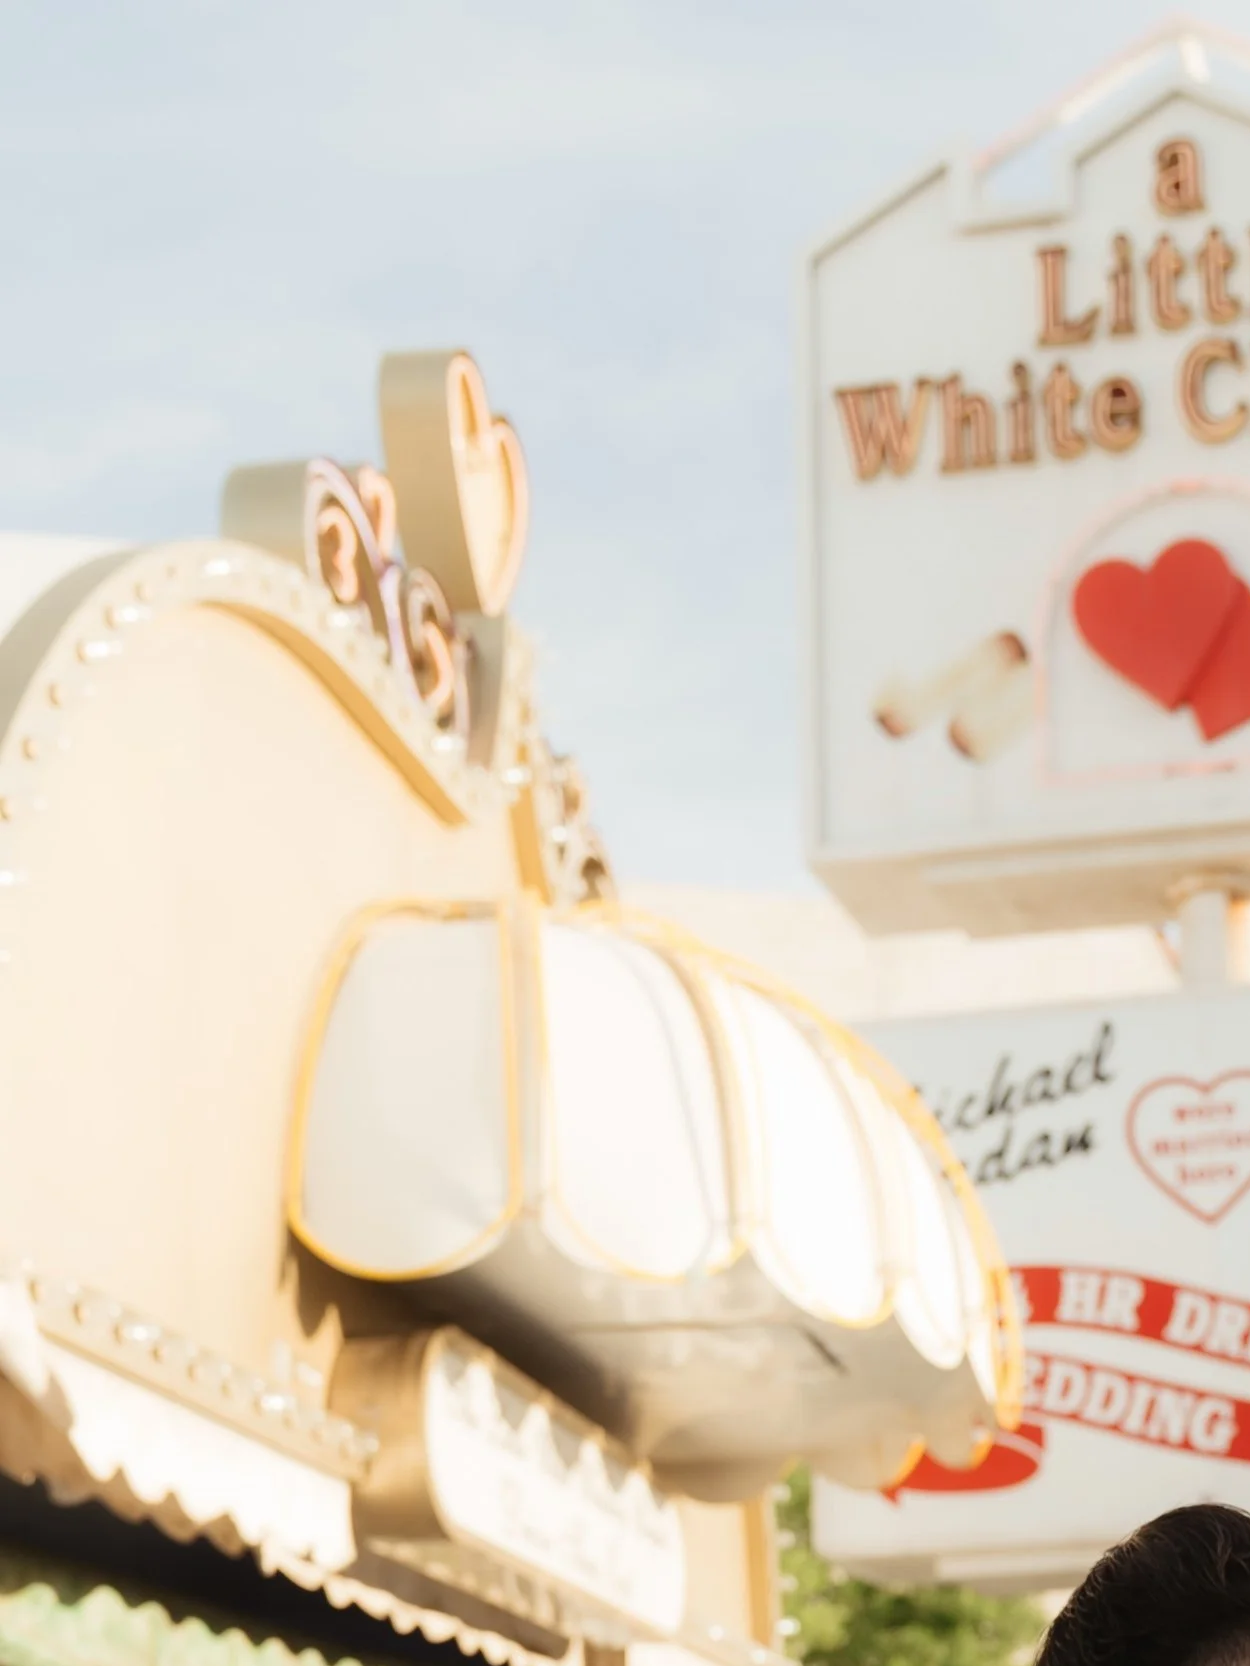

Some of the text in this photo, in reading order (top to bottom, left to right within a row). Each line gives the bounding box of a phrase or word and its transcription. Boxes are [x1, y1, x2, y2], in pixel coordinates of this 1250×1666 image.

[1152, 136, 1206, 217] a
[834, 357, 1145, 483] White
[934, 1022, 1113, 1133] ichael
[968, 1114, 1095, 1184] dan
[1056, 1270, 1145, 1333] HR
[1024, 1354, 1237, 1454] EDDING
